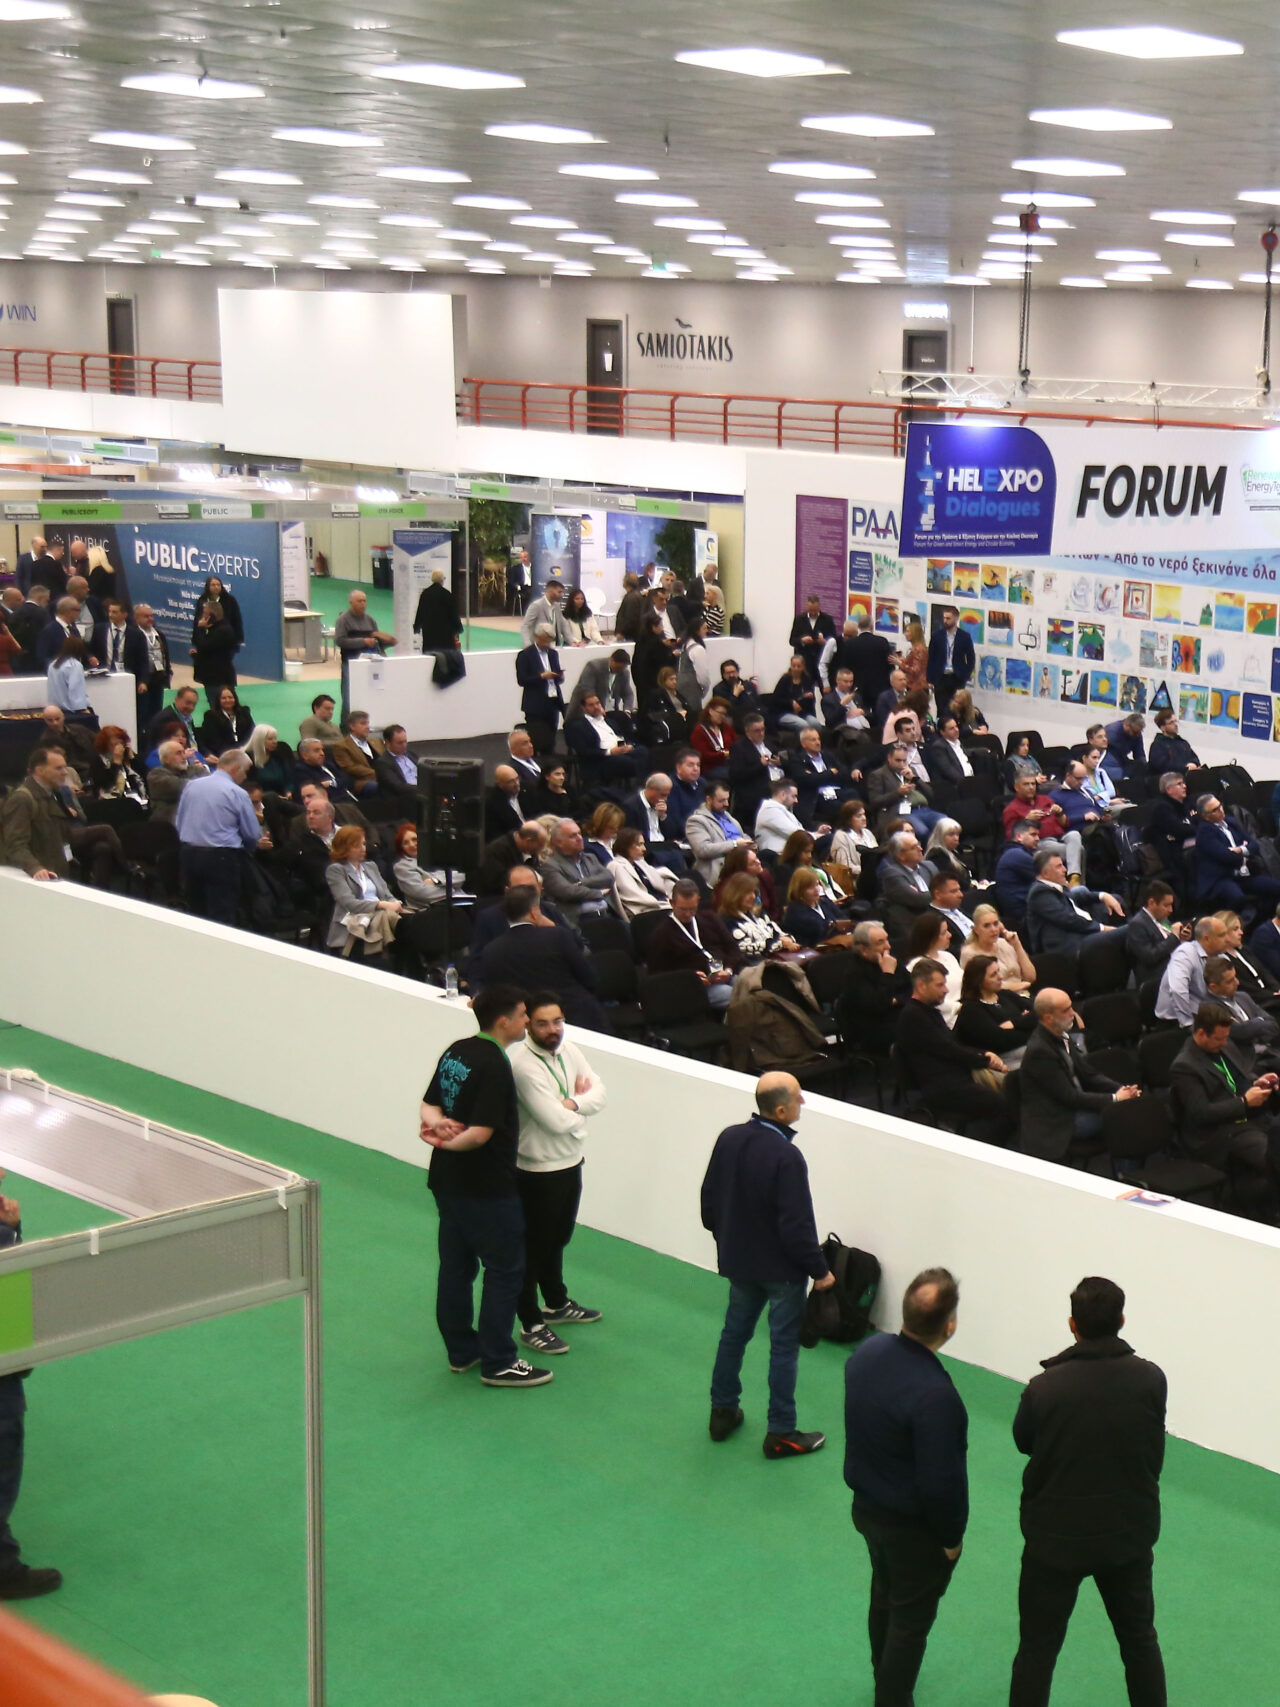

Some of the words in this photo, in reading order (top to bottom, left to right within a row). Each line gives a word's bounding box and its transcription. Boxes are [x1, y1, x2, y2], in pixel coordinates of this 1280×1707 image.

[7, 304, 36, 322] WIN
[636, 332, 734, 362] SAMIOTAKIS
[947, 467, 1044, 493] HELEXPO
[1076, 464, 1228, 519] FORUM
[945, 496, 1041, 521] Dialogues
[135, 540, 260, 579] PUBLICEXPERTS
[1114, 552, 1138, 565] Από
[1143, 557, 1155, 567] το
[1159, 554, 1188, 573] νερό
[1192, 557, 1248, 578] ξεκινάνε
[1252, 564, 1276, 580] όλα
